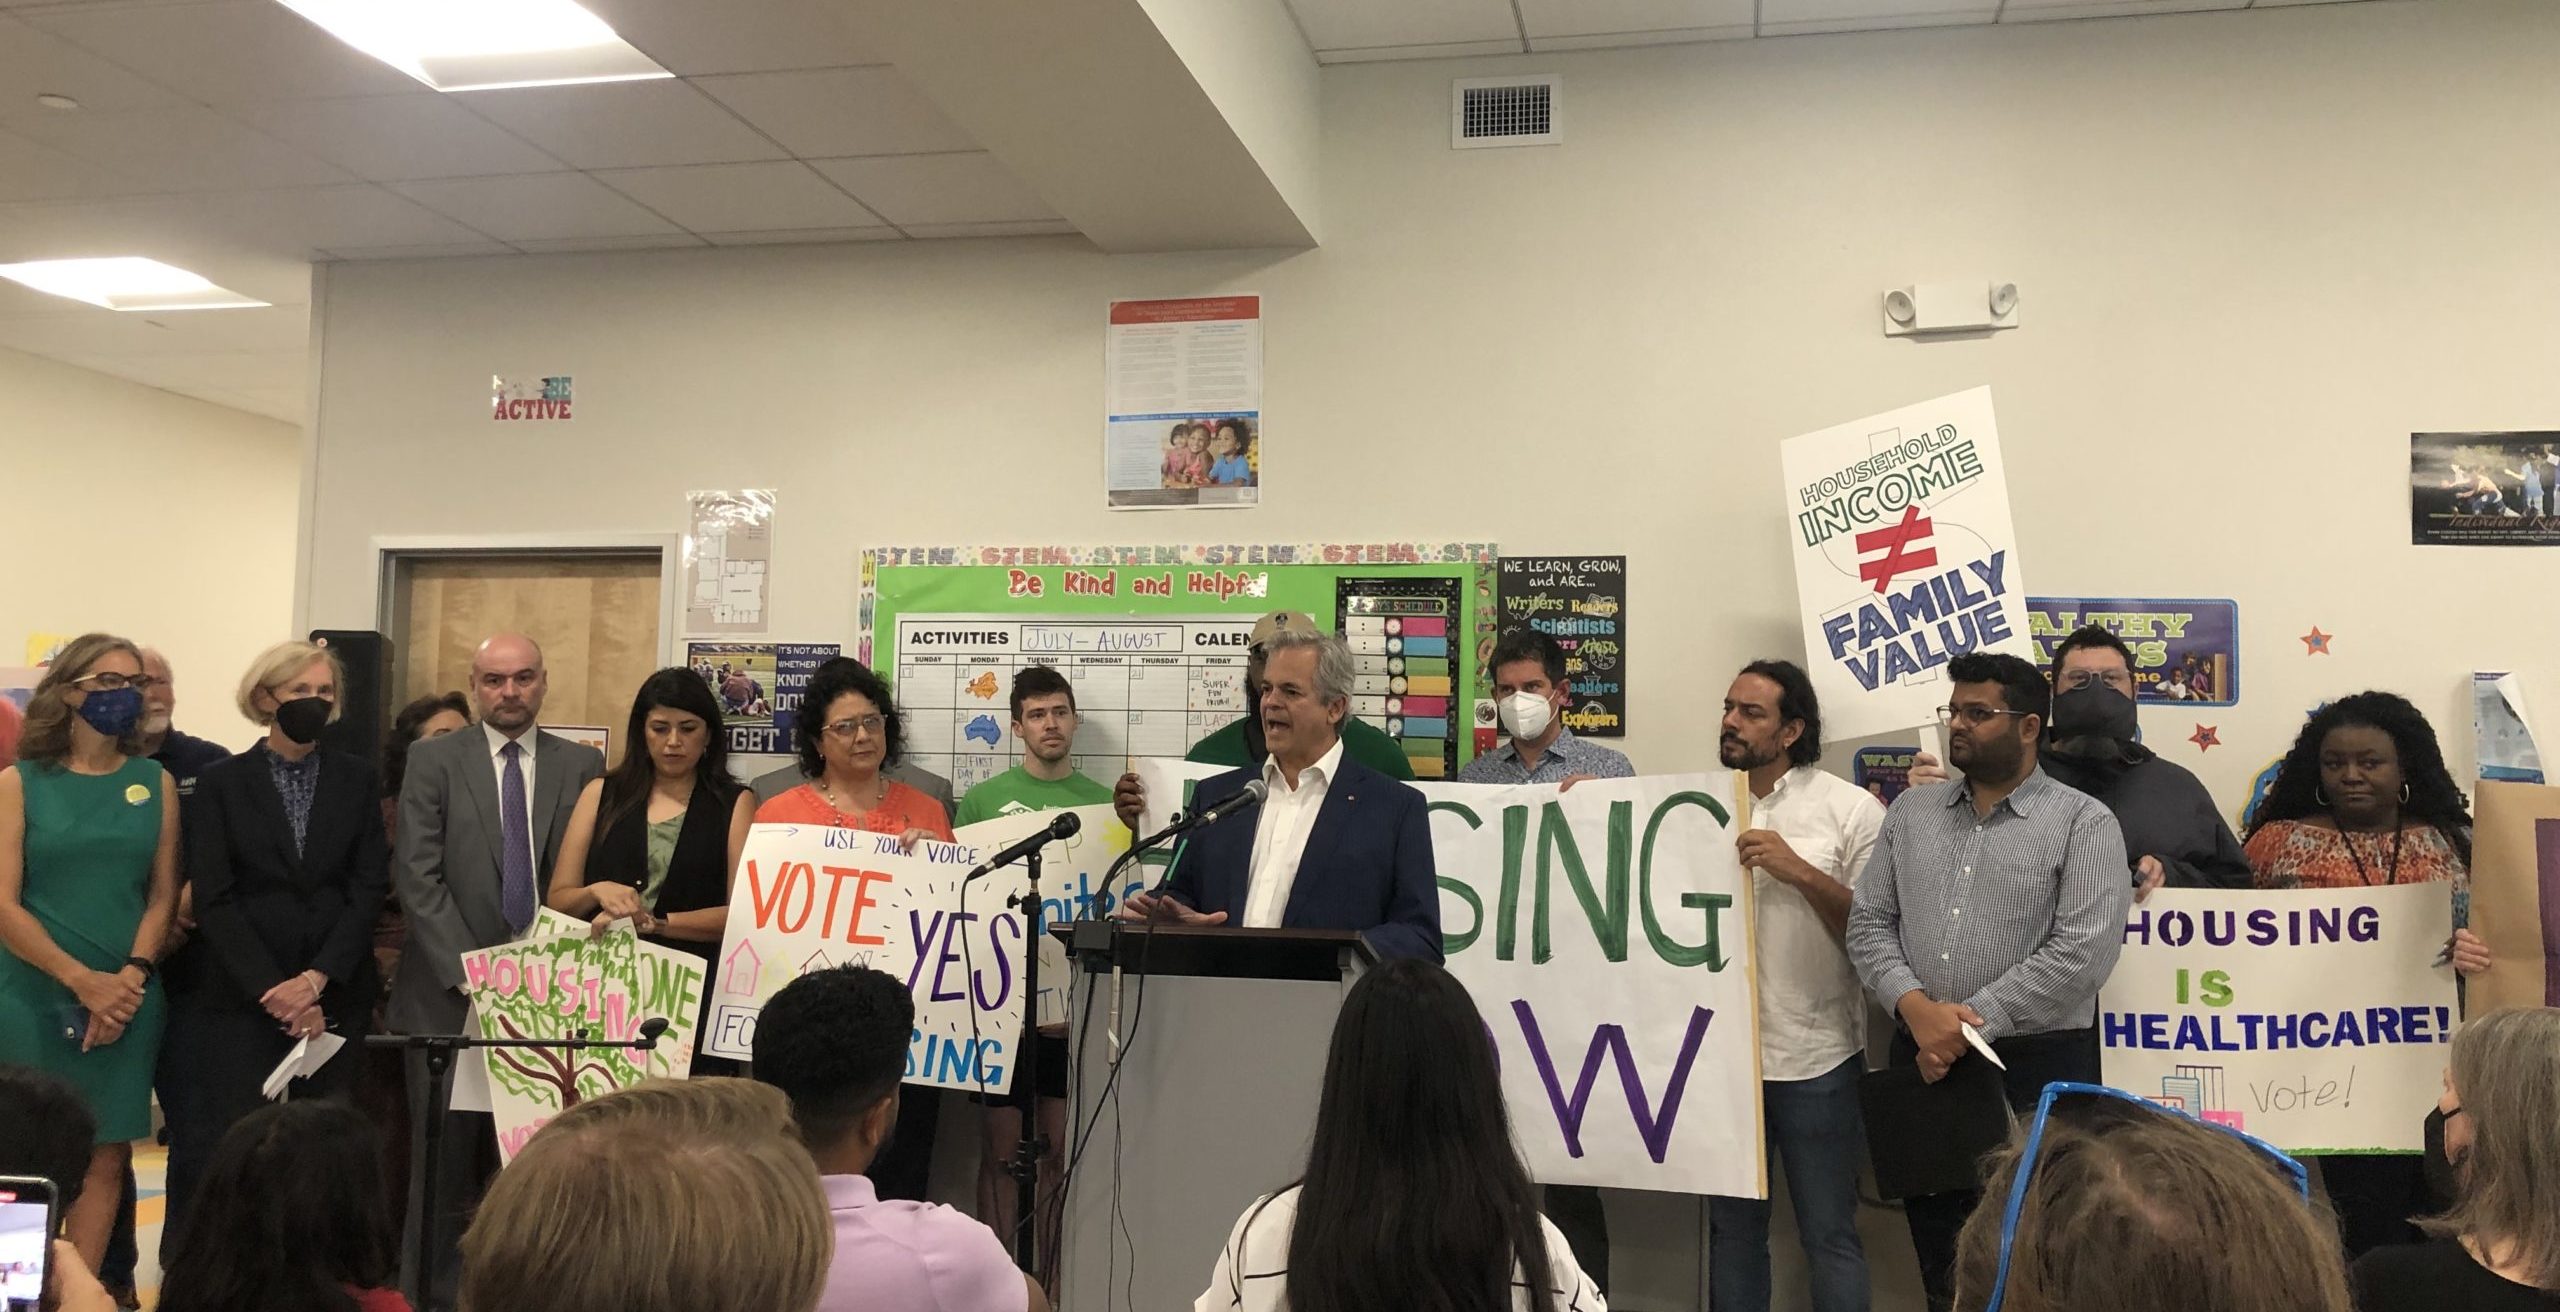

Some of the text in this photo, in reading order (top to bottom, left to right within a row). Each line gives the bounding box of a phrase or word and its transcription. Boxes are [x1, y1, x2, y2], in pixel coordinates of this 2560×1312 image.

[494, 398, 572, 420] ACTIVE
[1800, 423, 1957, 507] HOUSEHOLD
[1798, 439, 1984, 548] INCOME
[981, 547, 1069, 566] STEM
[1093, 546, 1181, 565] STEM
[1205, 545, 1295, 564] STEM
[1323, 544, 1417, 563] STEM
[1504, 560, 1621, 575] WE LEARN, GROW,
[1008, 569, 1268, 602] Be Kind and Helpf
[1529, 576, 1555, 587] and
[1393, 601, 1441, 612] SCHEDULE
[1505, 596, 1618, 613] Writers Readers
[1822, 549, 2006, 660] FAMILY
[1530, 618, 1616, 635] Scientists
[2029, 611, 2192, 638] ALTHY
[911, 632, 1009, 645] ACTIVITIES
[1098, 630, 1168, 651] AUGUST
[1195, 632, 1252, 646] CALEN
[1844, 600, 2013, 691] VALUE
[778, 646, 840, 655] IT'S NOT ABOUT
[778, 660, 816, 669] WHETHER
[1026, 656, 1059, 664] TUESDAY
[1141, 657, 1179, 665] THURSDAY
[1205, 657, 1232, 665] FRIDAY
[776, 674, 814, 687] KNOC
[1202, 679, 1230, 689] SUPER
[1570, 681, 1619, 694] eaders
[1208, 689, 1223, 697] FUN
[1204, 714, 1236, 727] LAST
[1562, 710, 1618, 729] Explorers
[969, 756, 994, 767] FIRST
[1861, 754, 1913, 767] WAS
[957, 769, 993, 780] DAY OF
[825, 828, 863, 850] USE
[873, 834, 913, 858] YOUR
[926, 841, 980, 866] VOICE
[1428, 790, 1733, 972] SING
[747, 859, 893, 946] VOTE
[2121, 905, 2380, 947] HOUSING
[907, 908, 1021, 1012] YES
[2175, 968, 2235, 1008] IS
[465, 953, 648, 1066] HOUSING
[722, 1013, 754, 1047] FO
[2103, 1006, 2450, 1052] HEALTHCARE!
[904, 1027, 1004, 1087] SING
